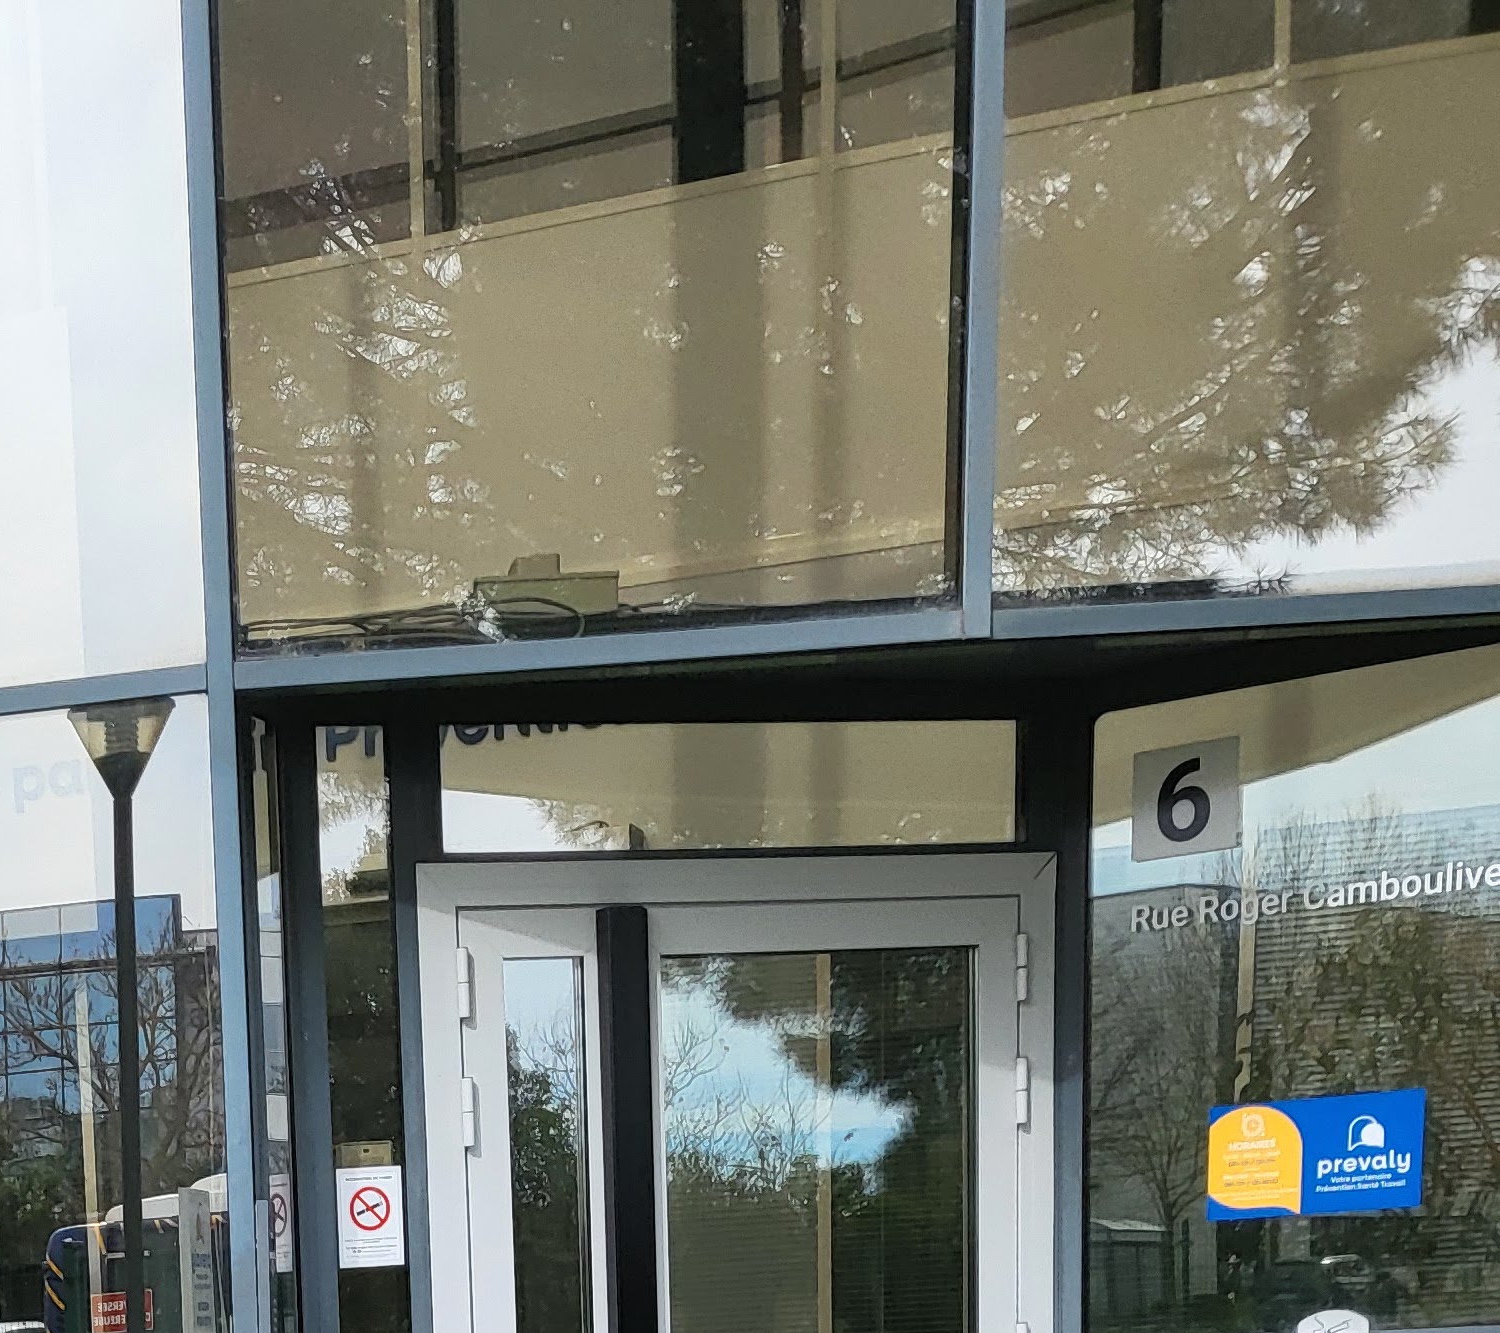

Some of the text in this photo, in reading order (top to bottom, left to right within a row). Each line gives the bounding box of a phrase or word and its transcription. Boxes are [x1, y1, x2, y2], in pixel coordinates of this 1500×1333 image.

[1157, 757, 1211, 842] 6
[1130, 903, 1188, 933] Rue
[1200, 888, 1293, 924] Roger
[1316, 1148, 1411, 1179] prevaly
